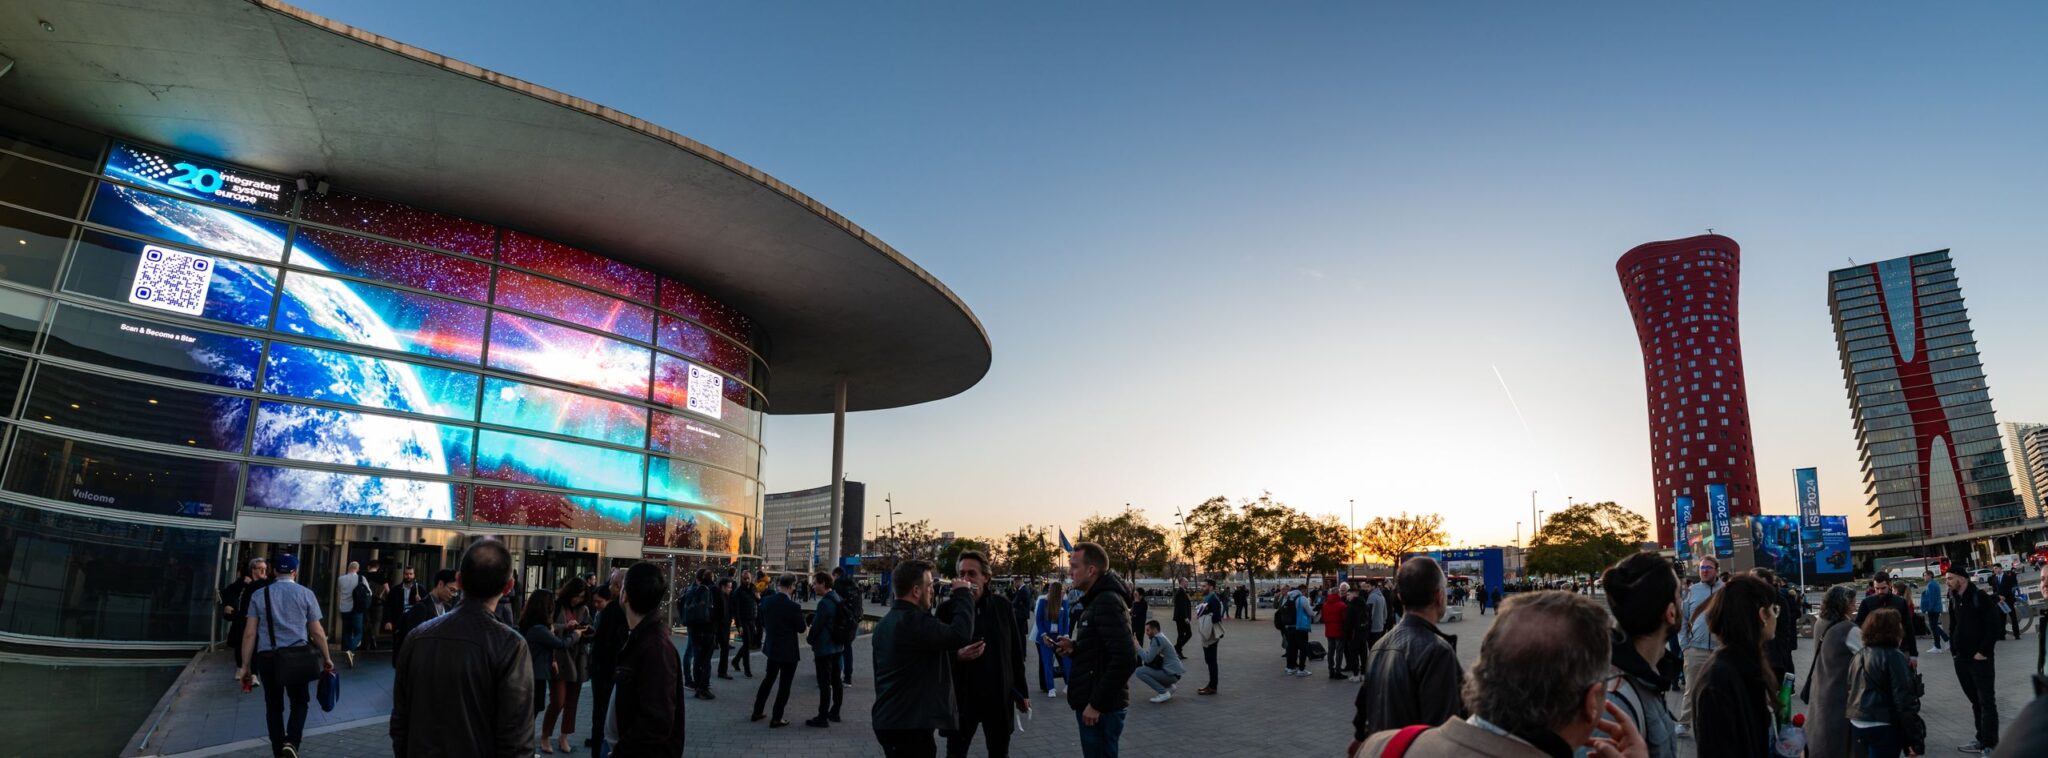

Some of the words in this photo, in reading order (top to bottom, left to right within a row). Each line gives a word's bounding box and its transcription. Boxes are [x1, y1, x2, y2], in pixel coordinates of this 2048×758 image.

[168, 163, 223, 193] 20
[219, 172, 281, 192] integrated
[214, 190, 257, 204] europe
[231, 185, 279, 200] systems
[120, 323, 138, 333] Scan
[146, 328, 174, 340] Become
[181, 335, 196, 343] Star
[72, 488, 115, 504] Welcome
[1806, 480, 1817, 506] 2024
[1716, 494, 1727, 518] 2024
[1809, 508, 1821, 527] ISE
[1719, 519, 1730, 536] ISE
